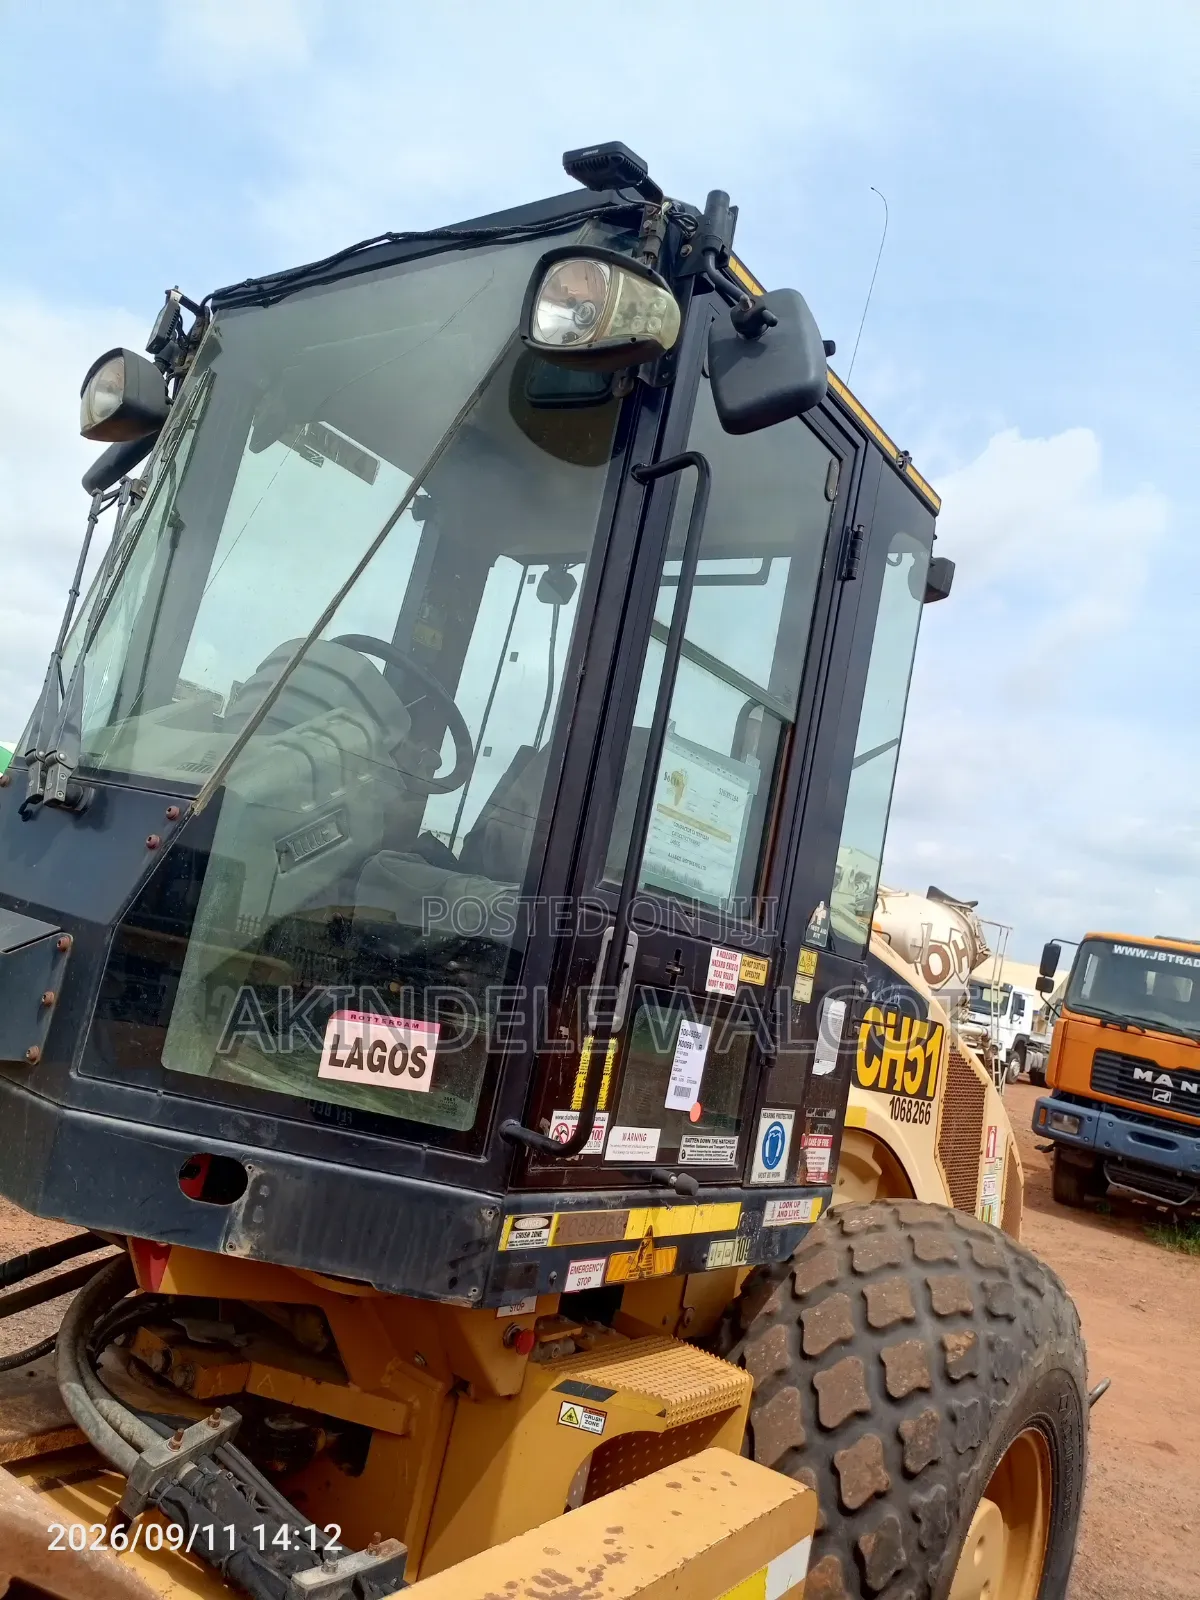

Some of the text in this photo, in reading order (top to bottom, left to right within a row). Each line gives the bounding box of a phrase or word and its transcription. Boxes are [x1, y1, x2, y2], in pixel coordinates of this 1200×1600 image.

[744, 969, 760, 980] OPERATOR
[707, 979, 736, 991] MUST BE WORN
[350, 1014, 420, 1029] ROTTERDAM
[328, 1033, 428, 1079] LAGOS
[1133, 1067, 1198, 1094] MAN
[889, 1096, 932, 1125] 1068266
[622, 1132, 647, 1142] WARNING
[809, 1138, 817, 1147] CASE
[817, 1138, 822, 1147] OF
[822, 1138, 830, 1147] FIRE
[779, 1200, 801, 1209] LOOK UP
[777, 1210, 788, 1218] AND
[515, 1230, 543, 1239] CRUSH ZONE
[570, 1262, 604, 1275] EMERGENCY
[577, 1276, 592, 1287] STOP
[509, 1302, 525, 1313] STOP
[583, 1413, 603, 1422] CRUSH
[584, 1420, 600, 1428] ZONE
